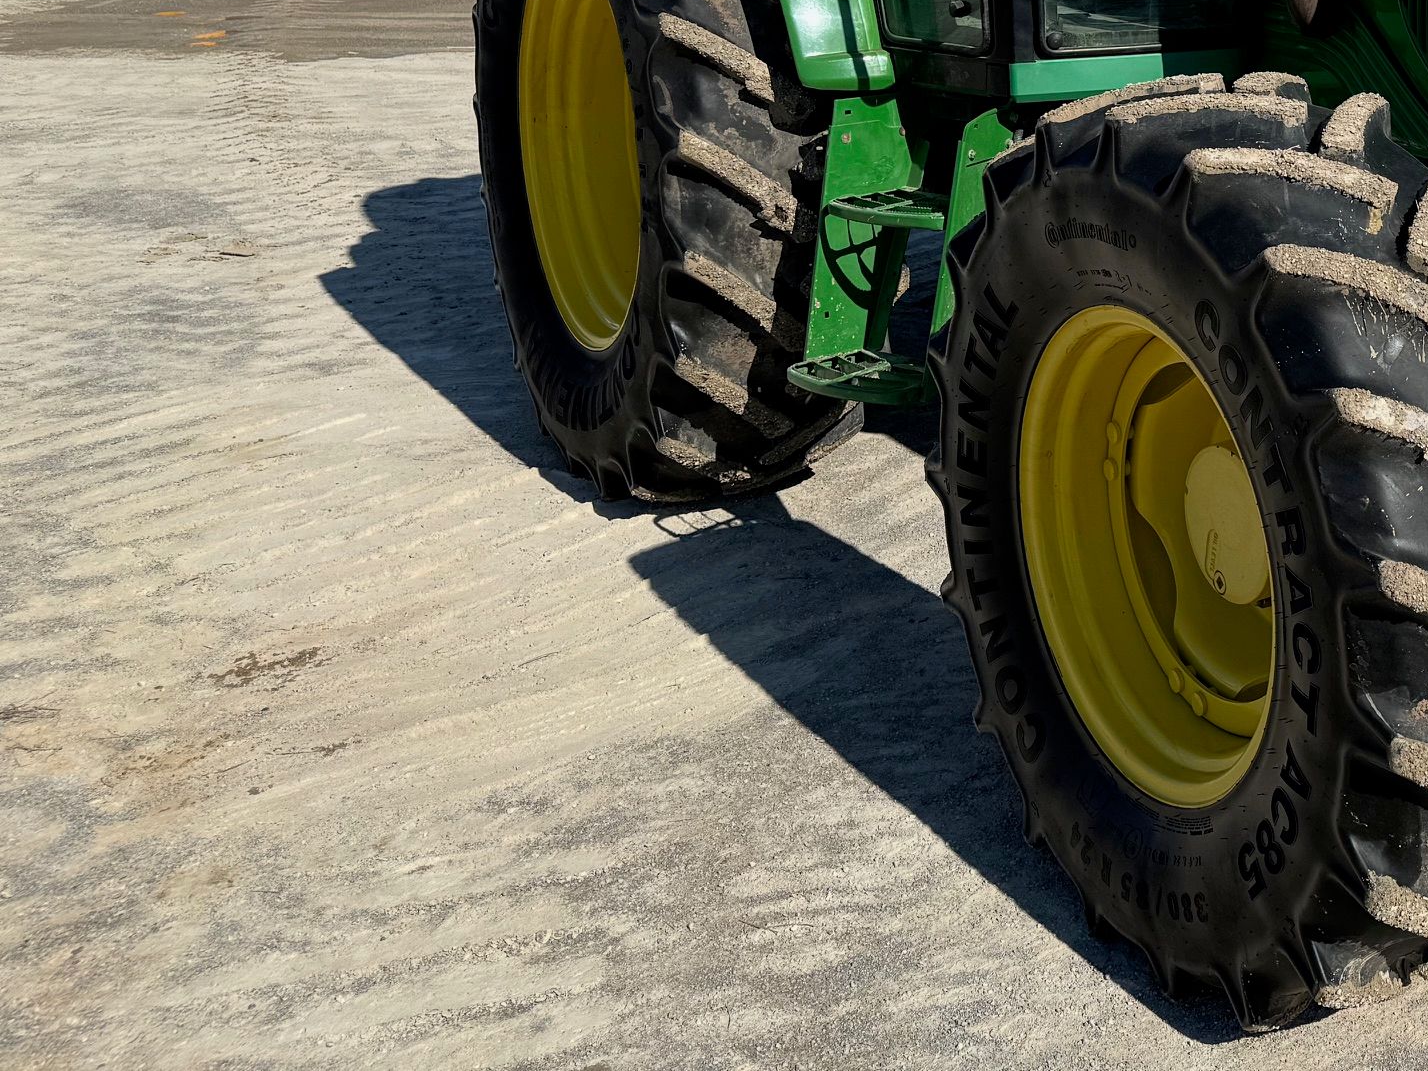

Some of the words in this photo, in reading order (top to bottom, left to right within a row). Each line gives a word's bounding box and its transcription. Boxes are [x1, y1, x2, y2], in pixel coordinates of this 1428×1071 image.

[1045, 217, 1129, 251] Continental
[957, 282, 1045, 765] CONTINENTAL
[1194, 298, 1322, 737] CONTRACT
[1120, 872, 1209, 923] 380/85
[1238, 738, 1312, 901] AC85
